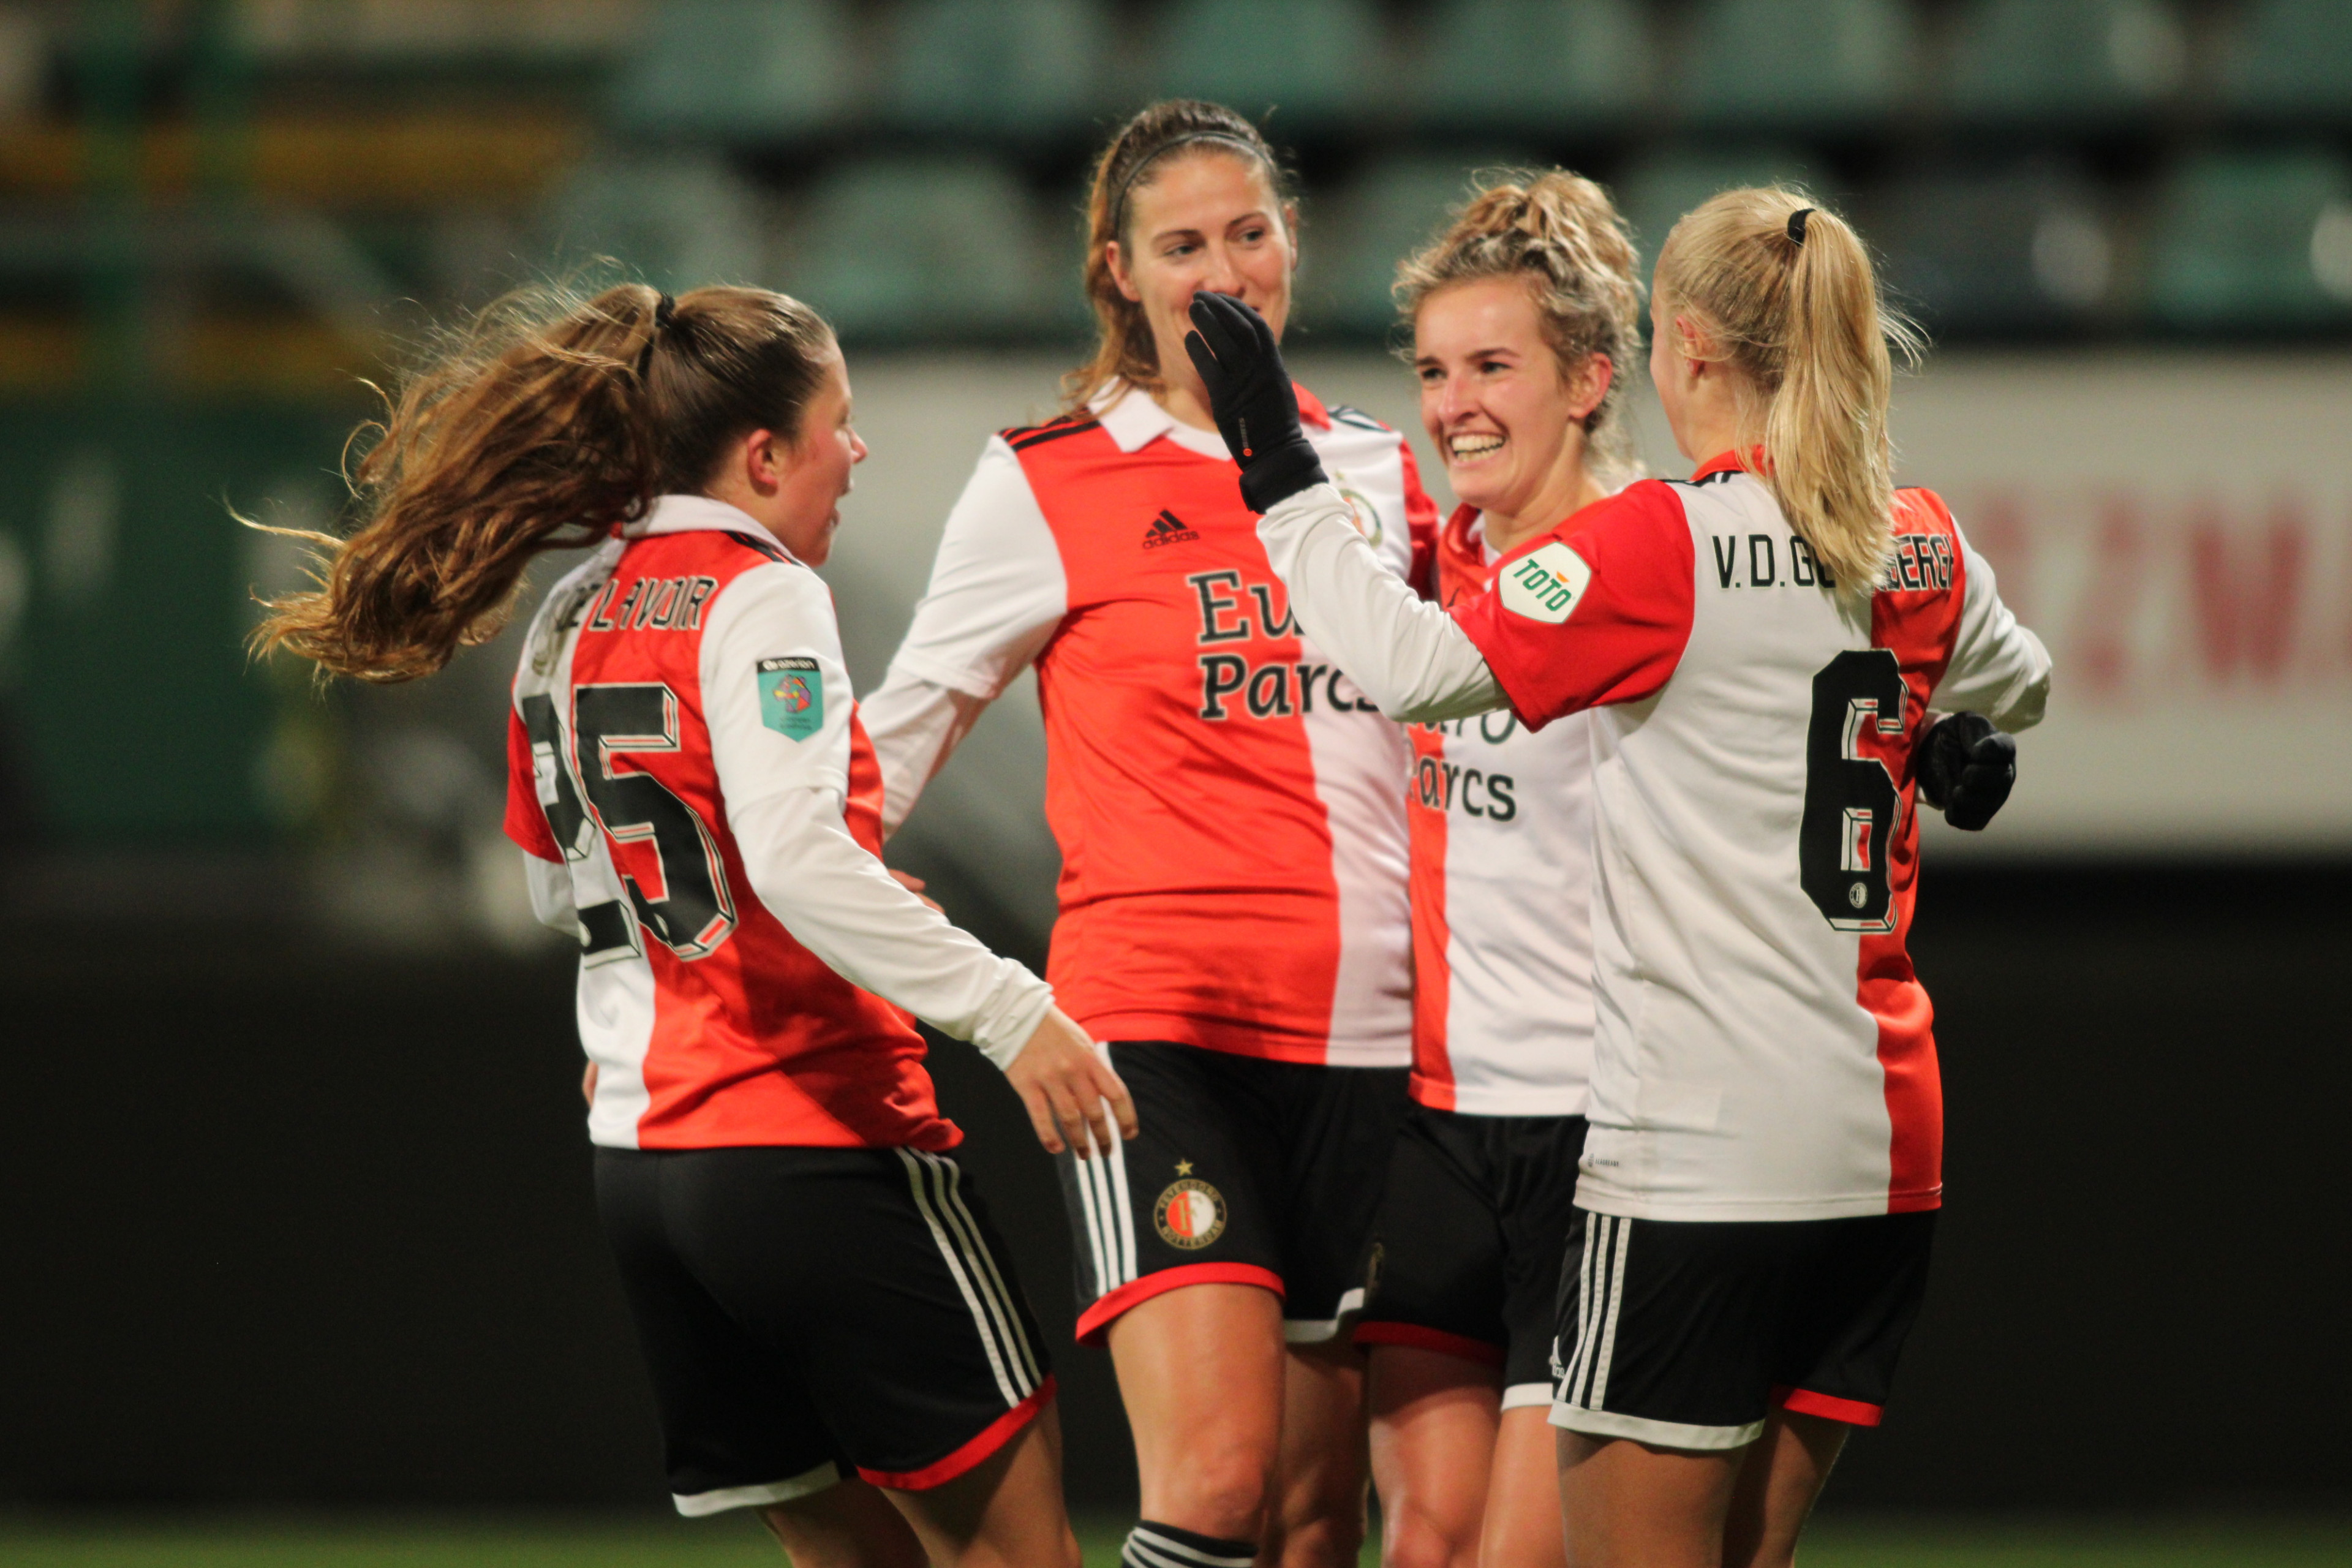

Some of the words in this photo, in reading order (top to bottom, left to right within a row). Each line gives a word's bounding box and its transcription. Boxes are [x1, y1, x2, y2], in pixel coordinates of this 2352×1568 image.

[1143, 530, 1199, 549] adidas
[1186, 568, 1306, 646] Eu
[1513, 559, 1572, 611] TOTO
[1406, 739, 1517, 823] arcs
[1799, 649, 1909, 934] 6
[522, 682, 739, 970] 25
